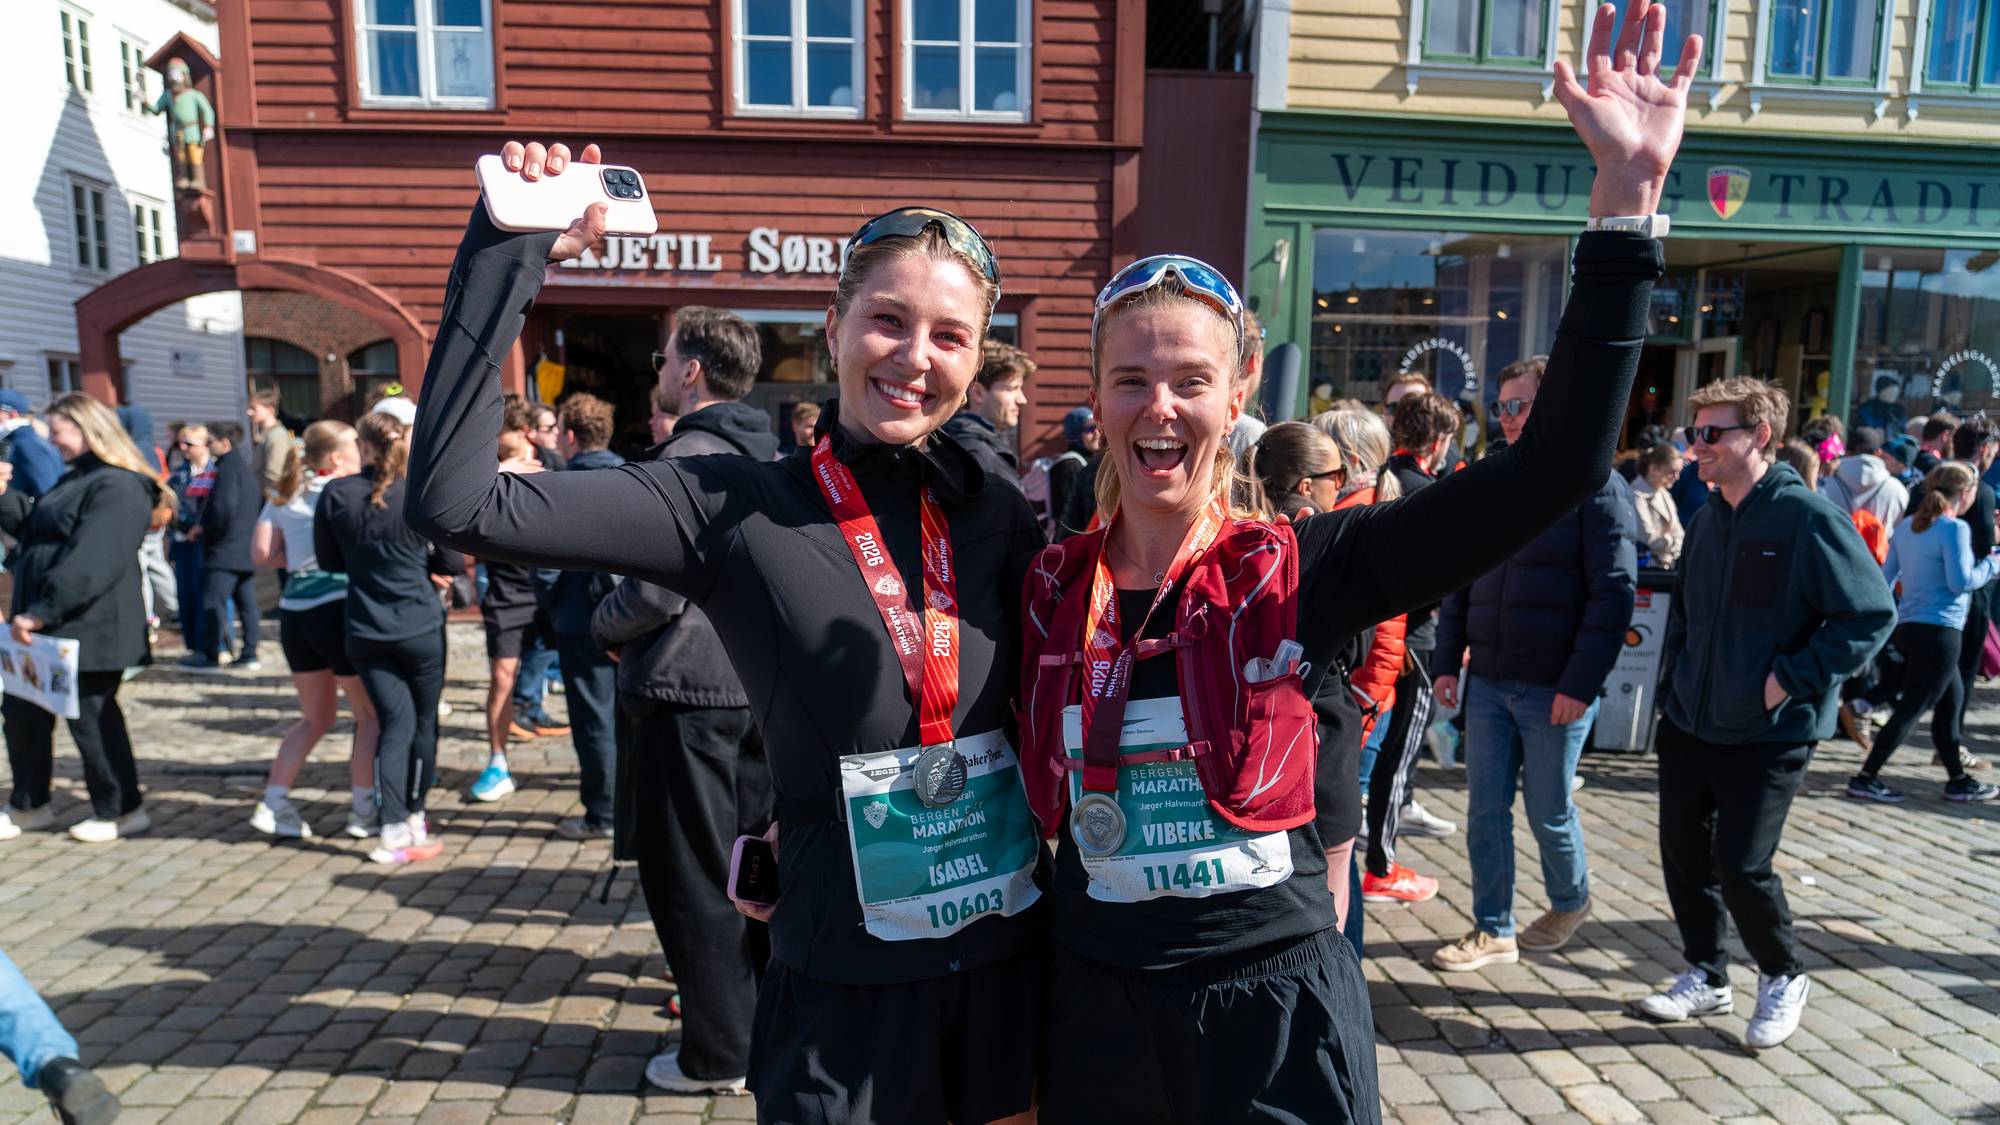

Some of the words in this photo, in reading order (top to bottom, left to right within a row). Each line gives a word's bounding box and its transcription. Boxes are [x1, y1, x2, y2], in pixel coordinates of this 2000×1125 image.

[1331, 153, 1684, 215] VEIDUG
[1768, 173, 2000, 227] TRADI
[1398, 337, 1477, 390] ANDELSGAARDEN
[817, 463, 842, 504] MARATHON
[855, 532, 885, 568] 2026
[1187, 515, 1212, 551] MARATHON
[939, 538, 950, 582] MARATHON
[887, 606, 912, 656] MARATHON
[894, 604, 911, 635] BERGEN
[907, 636, 918, 653] CITY
[933, 620, 951, 657] 2026
[870, 766, 901, 777] JÆGER
[1130, 767, 1183, 780] BERGEN
[1131, 777, 1204, 796] MARATH
[910, 809, 959, 825] BERGEN
[1140, 801, 1163, 812] Jæger
[912, 810, 986, 839] MARATHON
[1142, 819, 1216, 847] VIBEKE
[922, 843, 944, 854] Jæger
[944, 831, 987, 848] Halvmarathon
[928, 852, 988, 887] ISABEL
[1142, 857, 1226, 891] 11441
[926, 888, 1004, 929] 10603
